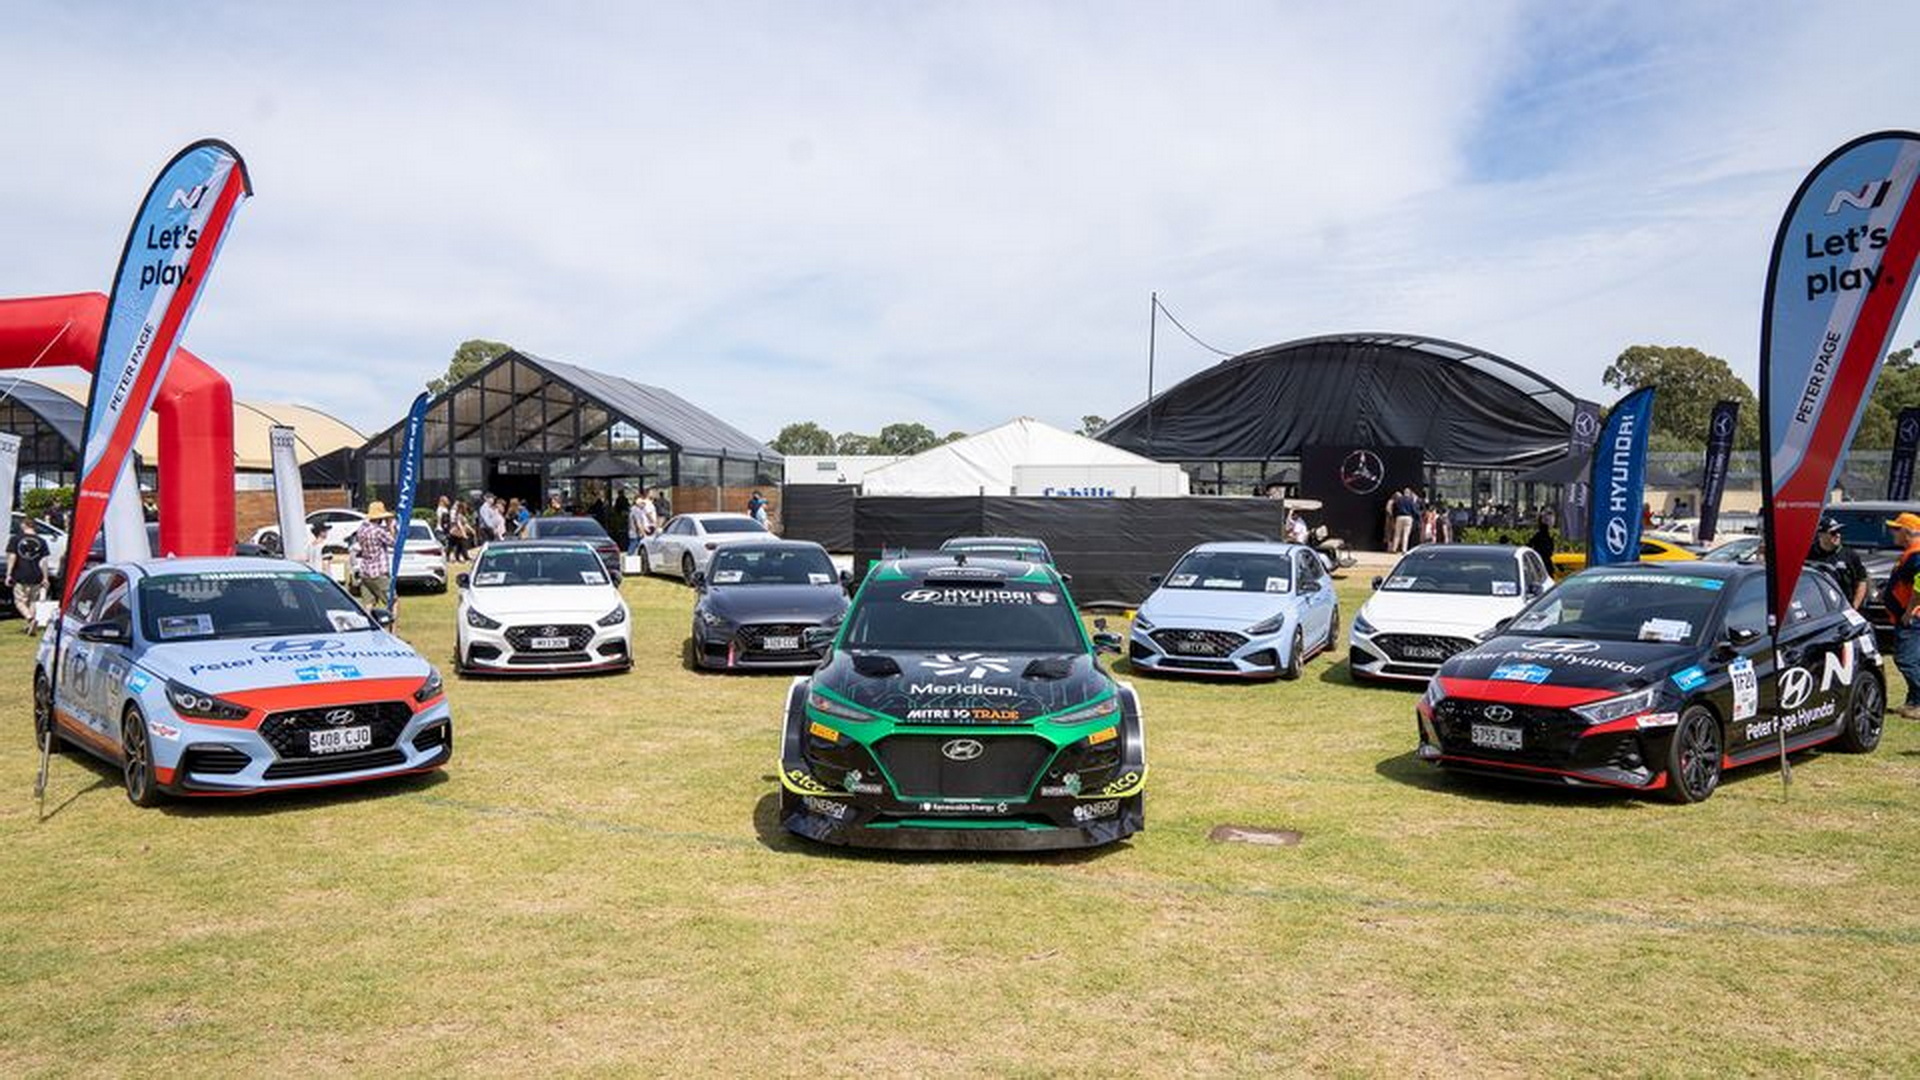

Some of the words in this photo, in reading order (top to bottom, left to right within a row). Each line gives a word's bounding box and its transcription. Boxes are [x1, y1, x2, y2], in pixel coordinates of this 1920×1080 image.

[147, 224, 198, 249] Let's
[1805, 225, 1888, 259] Let's
[139, 259, 193, 290] play.
[1806, 265, 1894, 301] play.
[109, 365, 136, 412] PETER
[132, 322, 155, 364] PAGE
[1795, 375, 1825, 424] PETER
[1814, 330, 1842, 375] PAGE
[1610, 413, 1636, 512] HYUNDAI
[944, 588, 1032, 600] HYUNDAI
[189, 657, 255, 676] Peter
[261, 653, 322, 664] Page
[327, 650, 416, 659] Hyunda
[1555, 653, 1645, 675] Hyundai
[910, 683, 1018, 697] Meridian.
[907, 709, 950, 719] MITRE
[952, 709, 970, 719] 10
[971, 710, 1019, 720] TRADE
[1746, 722, 1773, 740] Peter
